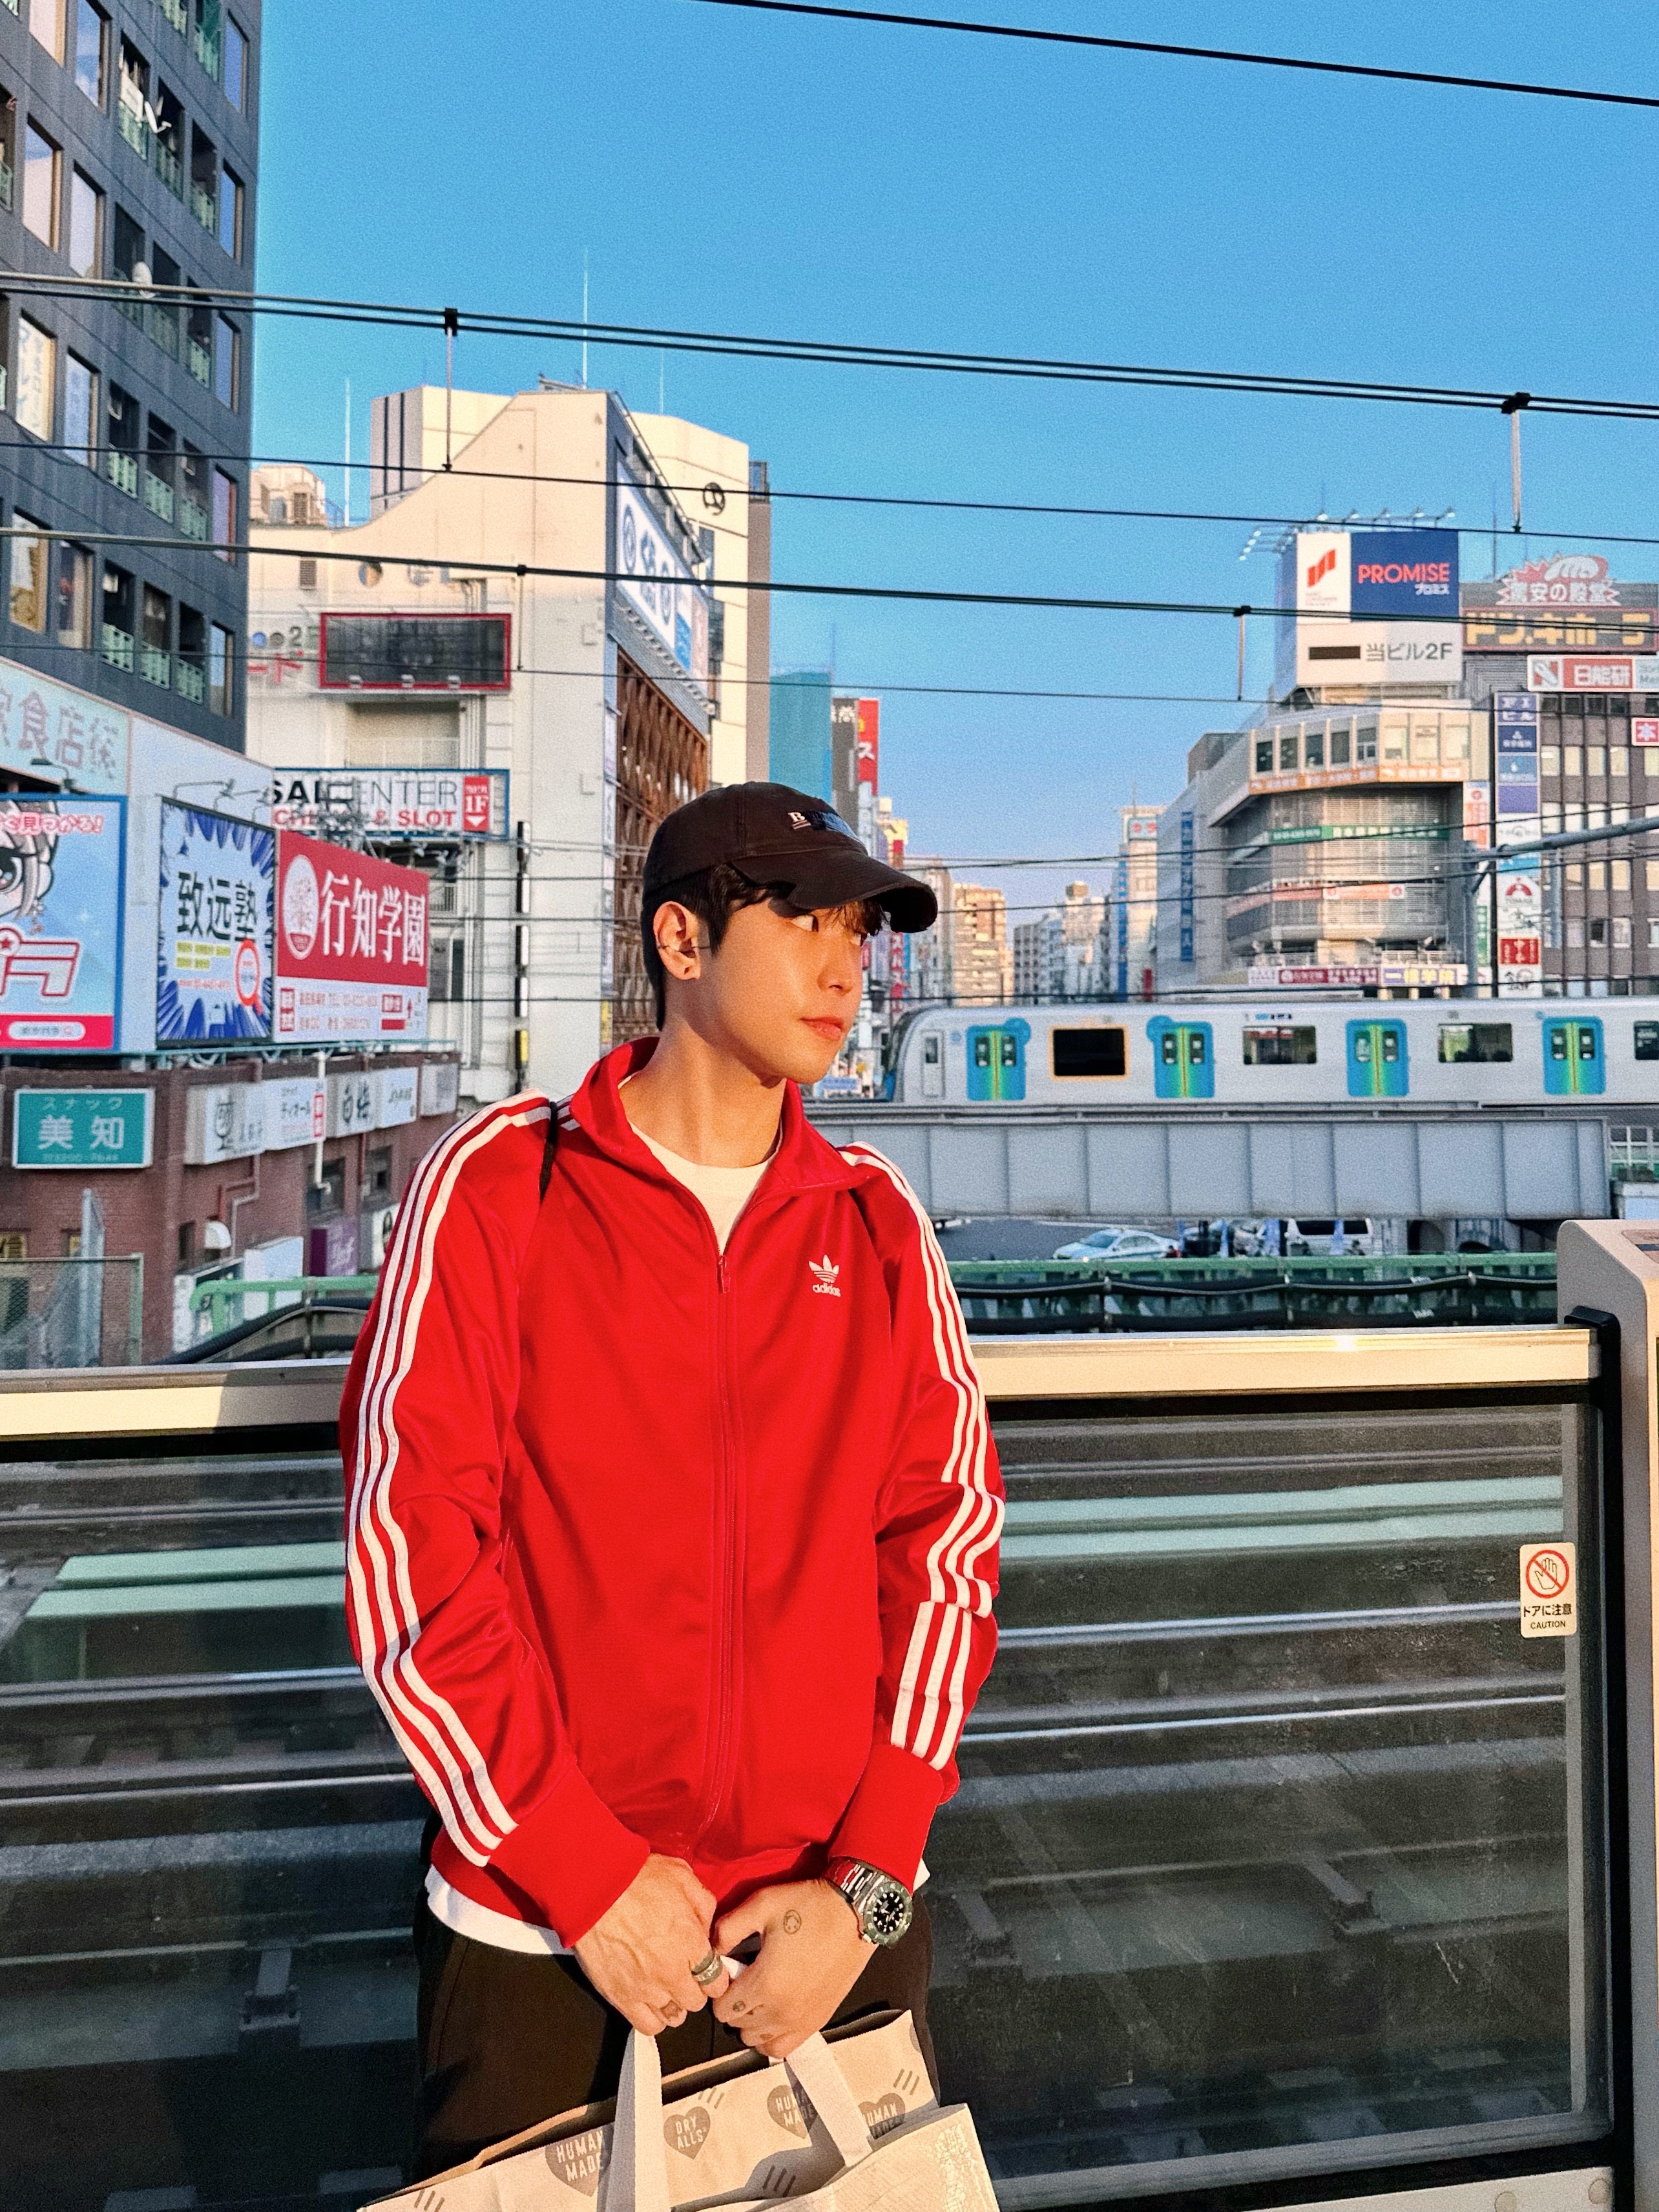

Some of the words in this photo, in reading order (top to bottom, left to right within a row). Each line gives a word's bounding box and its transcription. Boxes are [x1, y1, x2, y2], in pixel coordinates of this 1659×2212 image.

[1358, 563, 1450, 584] PROMISE
[1414, 583, 1450, 596] プロミス
[1365, 643, 1453, 662] 当ビル2F
[1573, 663, 1632, 686] 日能研
[354, 780, 458, 805] ENTER
[398, 810, 457, 828] SLOT
[321, 869, 426, 967] 行知学園
[41, 1096, 123, 1111] スナック
[37, 1114, 125, 1150] 美知
[812, 1282, 841, 1297] adidas
[1523, 1603, 1572, 1617] ドアに注意
[1530, 1620, 1566, 1629] CAUTION
[675, 2115, 696, 2135] DRY
[866, 2103, 898, 2127] UMAN
[677, 2129, 704, 2150] ALLS
[565, 2151, 604, 2182] MADE
